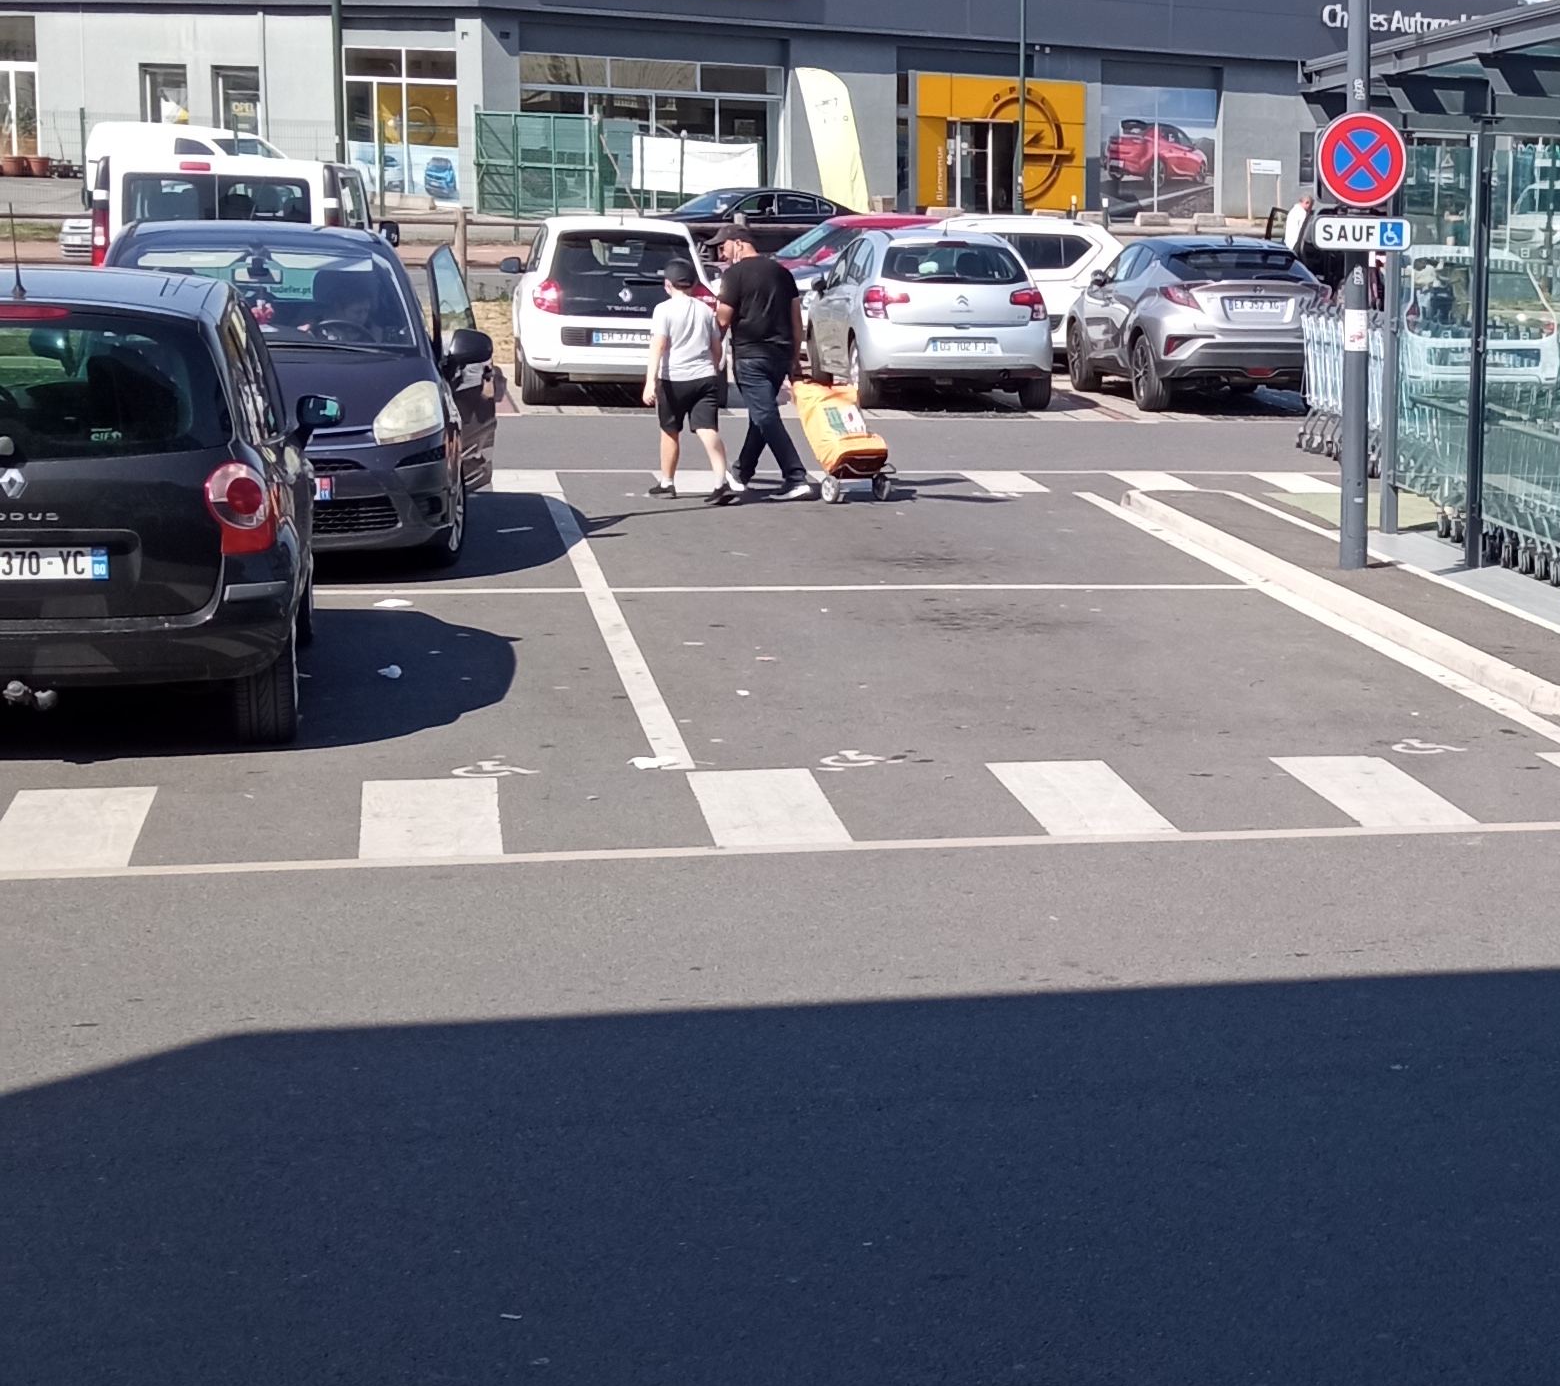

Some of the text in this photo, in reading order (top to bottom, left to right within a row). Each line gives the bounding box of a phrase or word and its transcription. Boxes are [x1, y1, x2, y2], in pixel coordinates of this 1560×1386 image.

[992, 86, 1048, 105] OPEL
[936, 146, 944, 202] Bienvenue
[1322, 224, 1376, 242] SAUF
